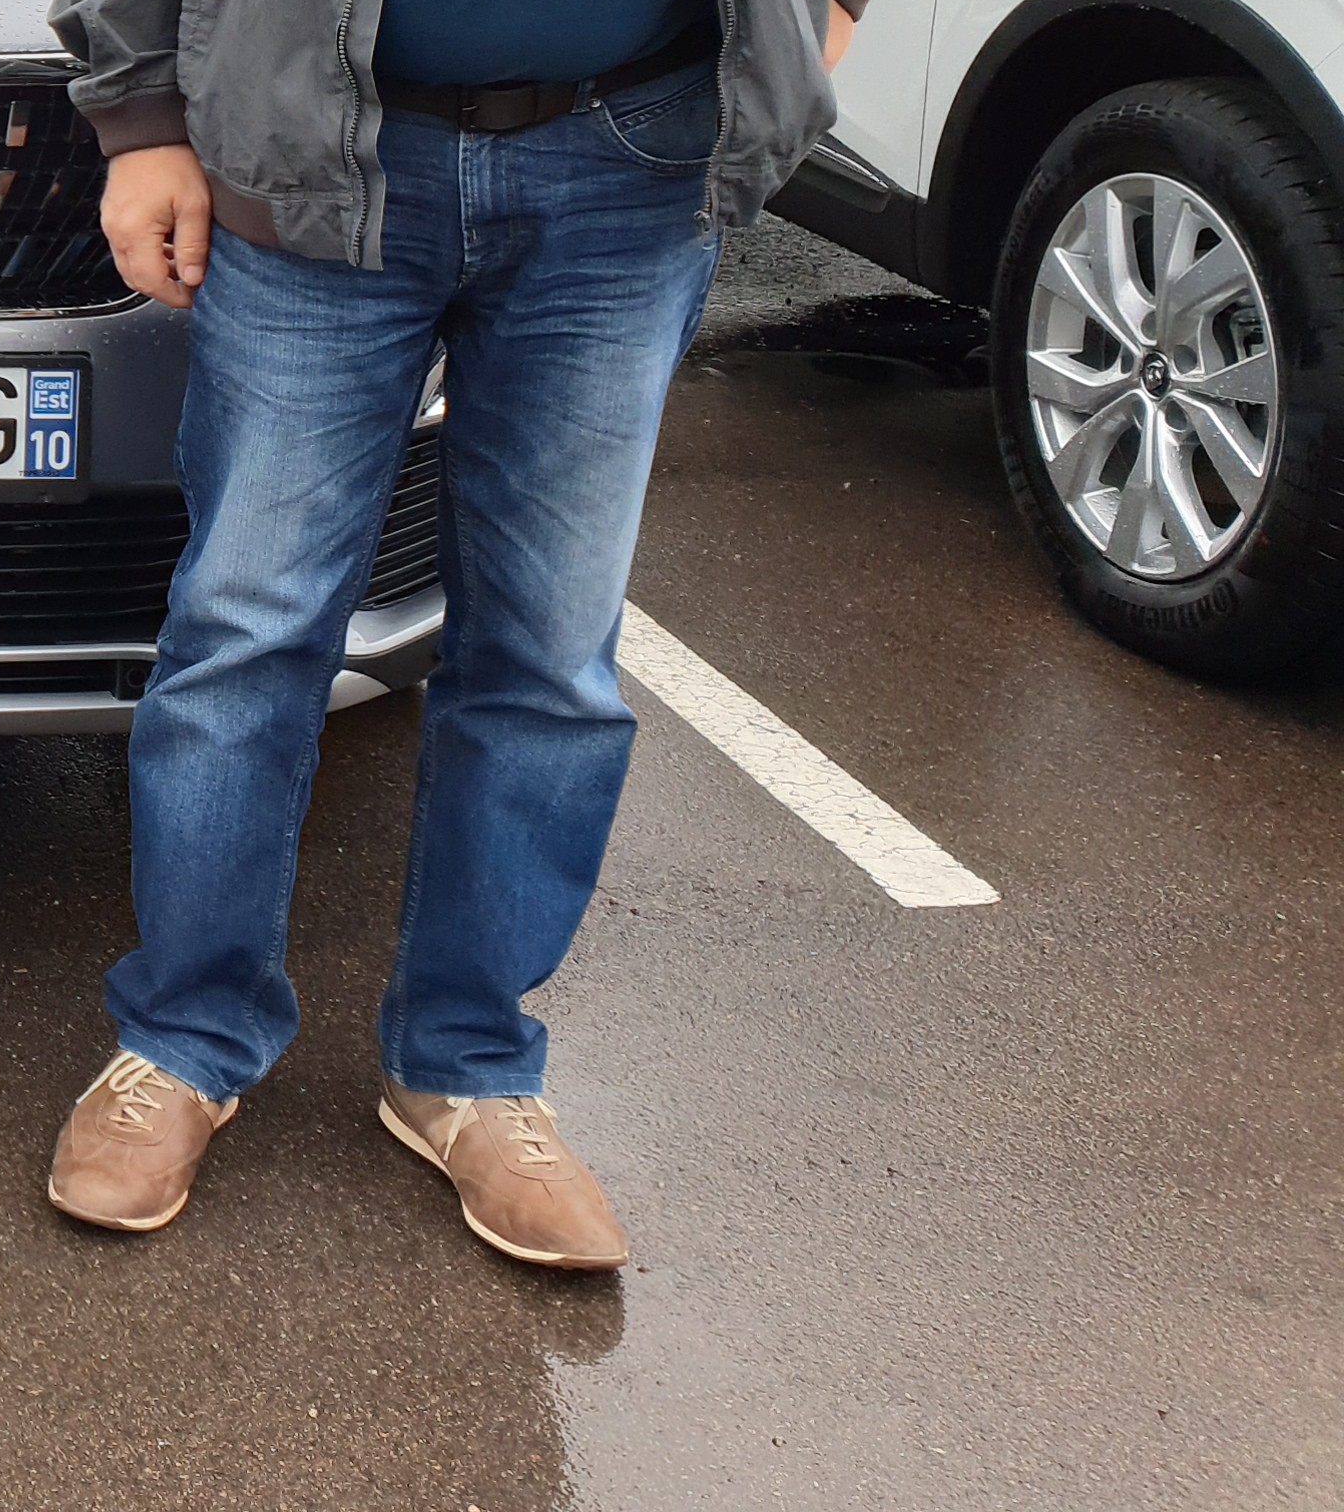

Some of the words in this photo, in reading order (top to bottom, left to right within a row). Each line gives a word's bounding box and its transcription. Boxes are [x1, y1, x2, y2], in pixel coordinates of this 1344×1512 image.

[34, 379, 70, 390] Grand
[34, 390, 69, 409] Est
[30, 430, 70, 470] 10
